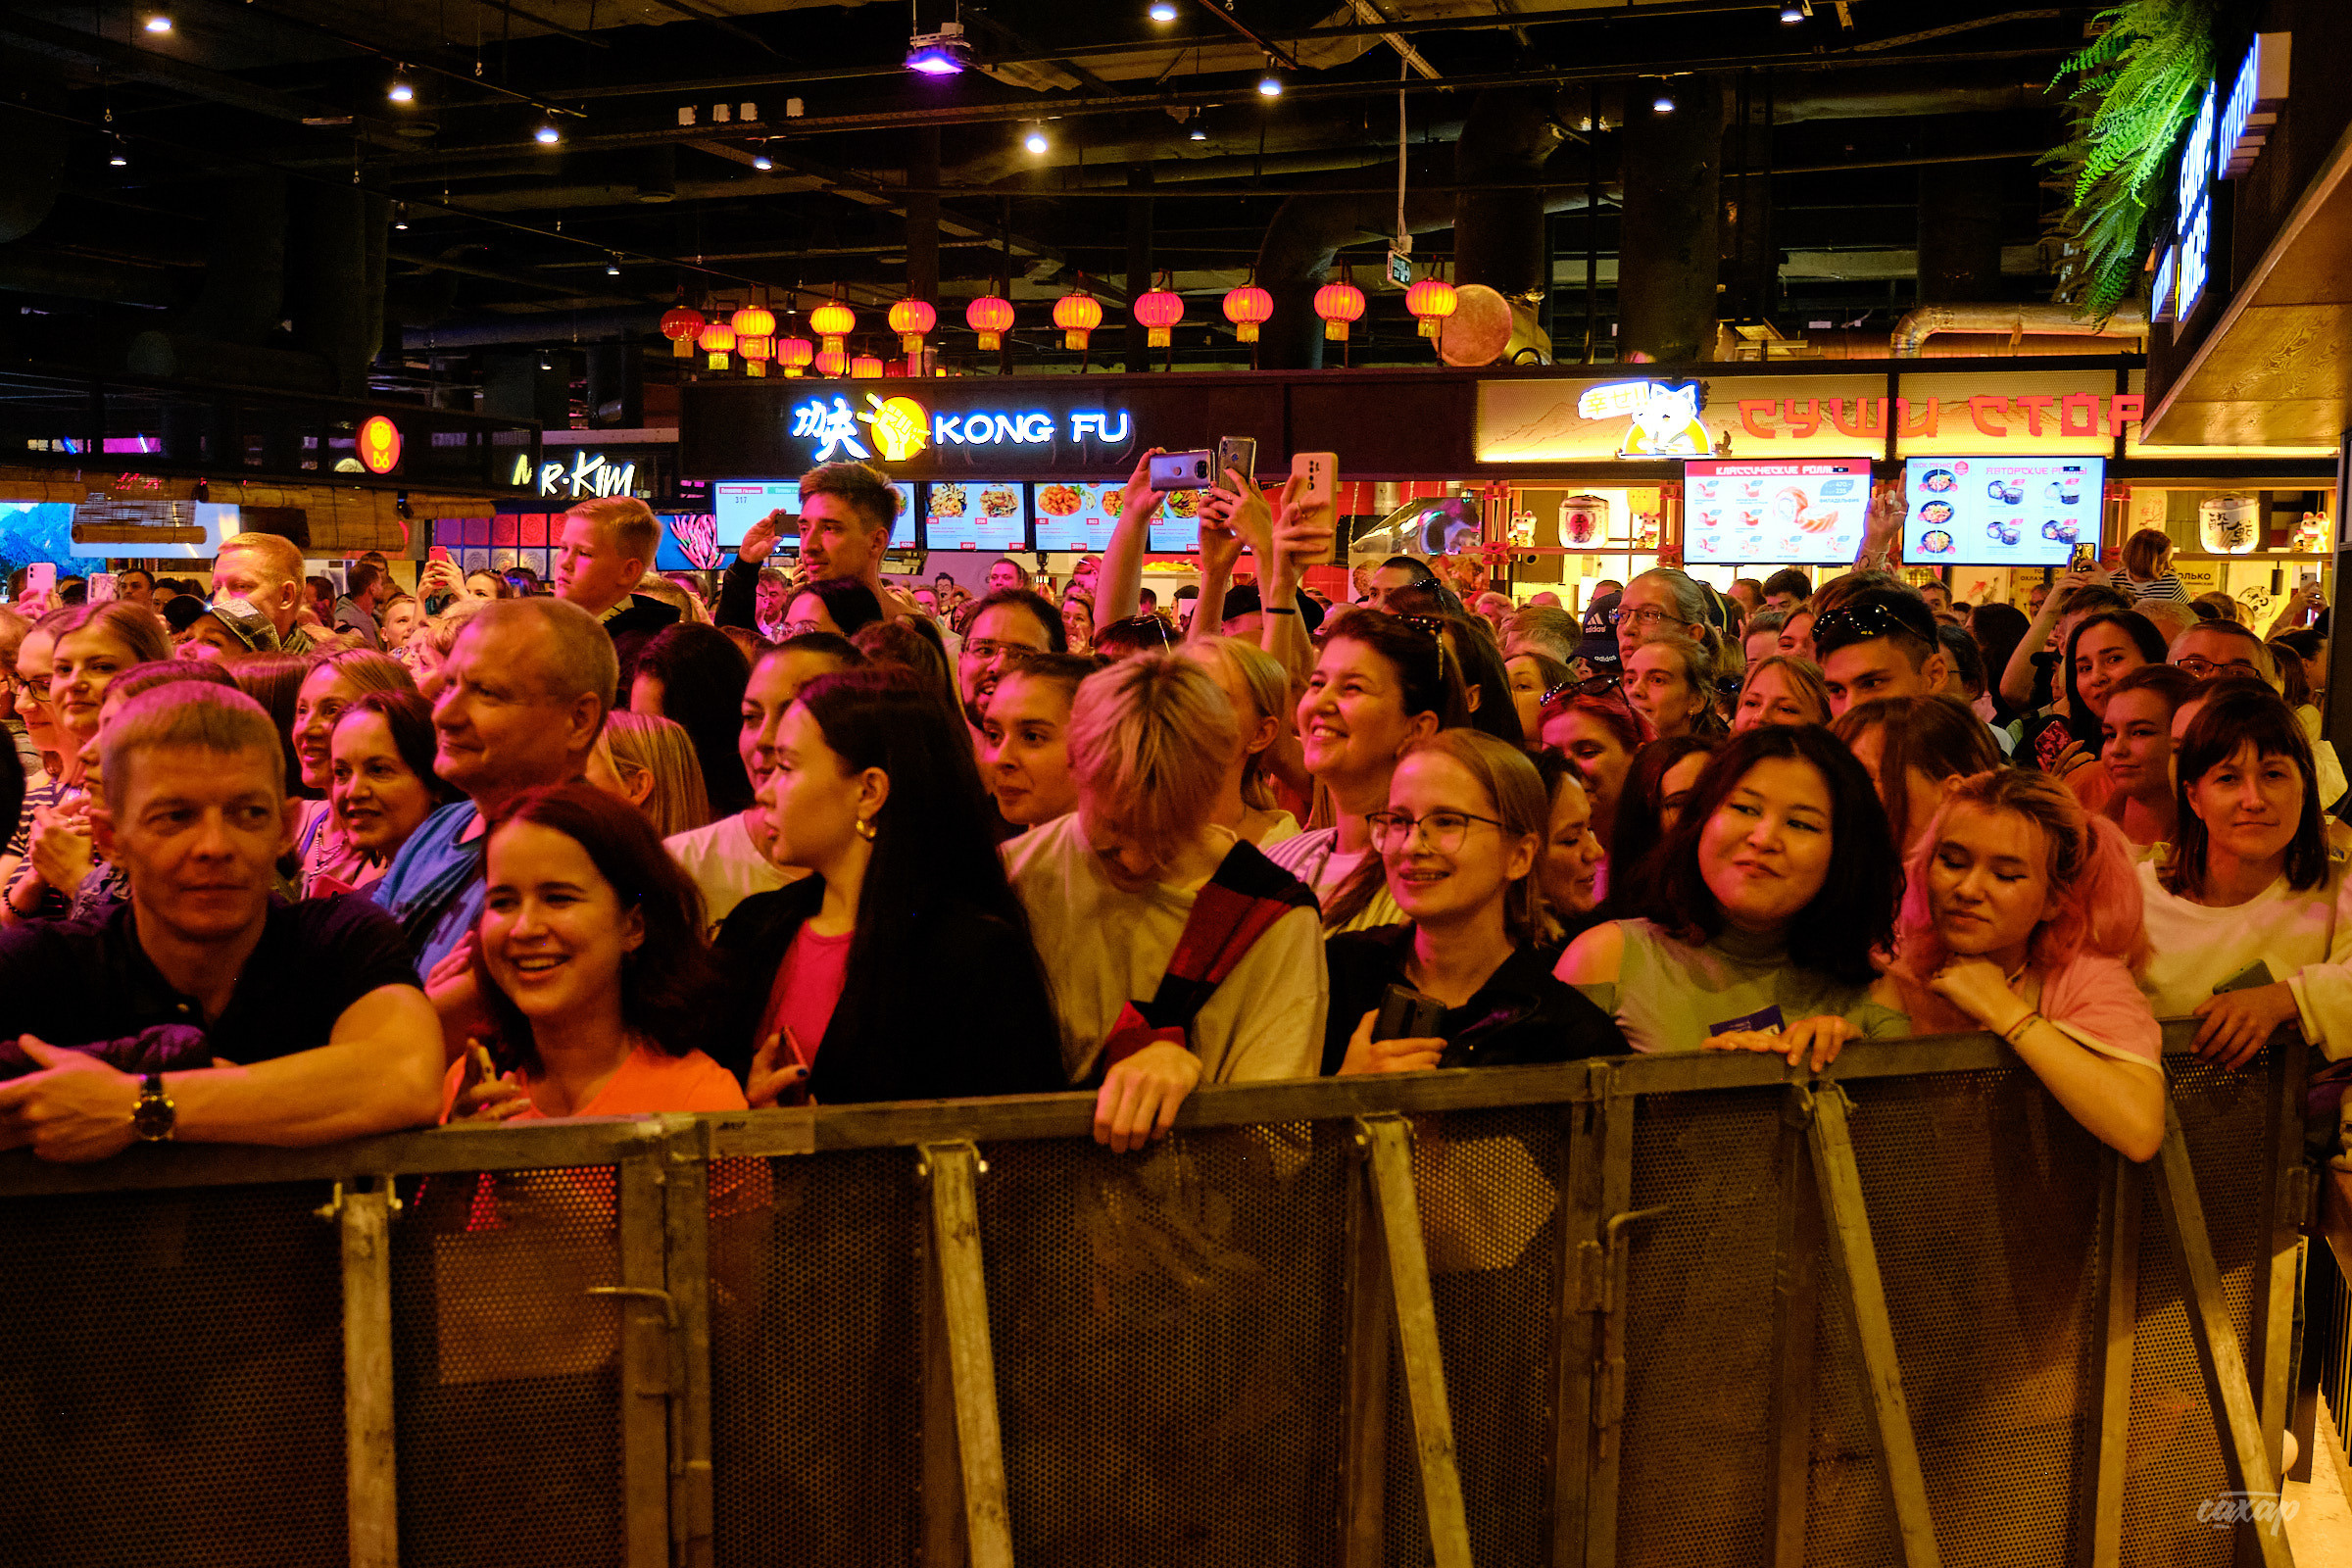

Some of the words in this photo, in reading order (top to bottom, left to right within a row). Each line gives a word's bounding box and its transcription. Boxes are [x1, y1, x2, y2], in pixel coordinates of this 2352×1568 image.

[792, 398, 871, 463] 功夫
[935, 415, 1055, 444] KONG
[1070, 412, 1129, 444] FU
[1738, 397, 1939, 438] СУШИ
[1969, 392, 2144, 437] СТОР
[1715, 466, 1798, 475] КЛАССИЧЕСКИЕ
[1985, 466, 2048, 475] АВТОРСКИЕ
